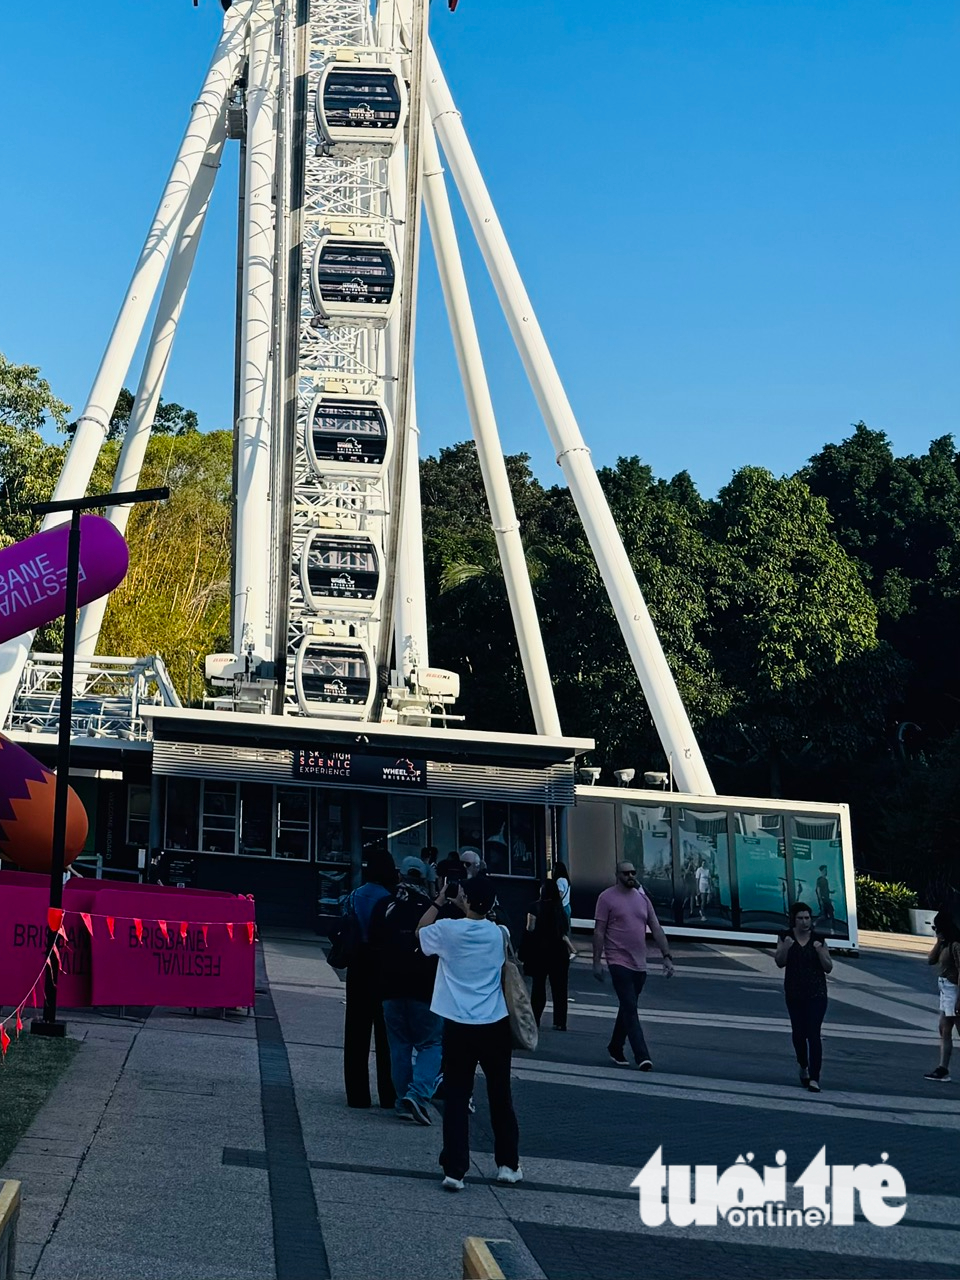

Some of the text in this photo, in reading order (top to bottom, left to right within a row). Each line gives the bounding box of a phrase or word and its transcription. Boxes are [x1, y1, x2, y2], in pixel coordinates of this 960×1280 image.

[300, 757, 350, 768] SCENIC
[300, 767, 351, 777] EXPERIENCE
[382, 768, 408, 776] WHEEL
[382, 774, 421, 782] BRISBANE
[129, 926, 205, 952] BRISBANE
[153, 952, 221, 976] FESTIVAL
